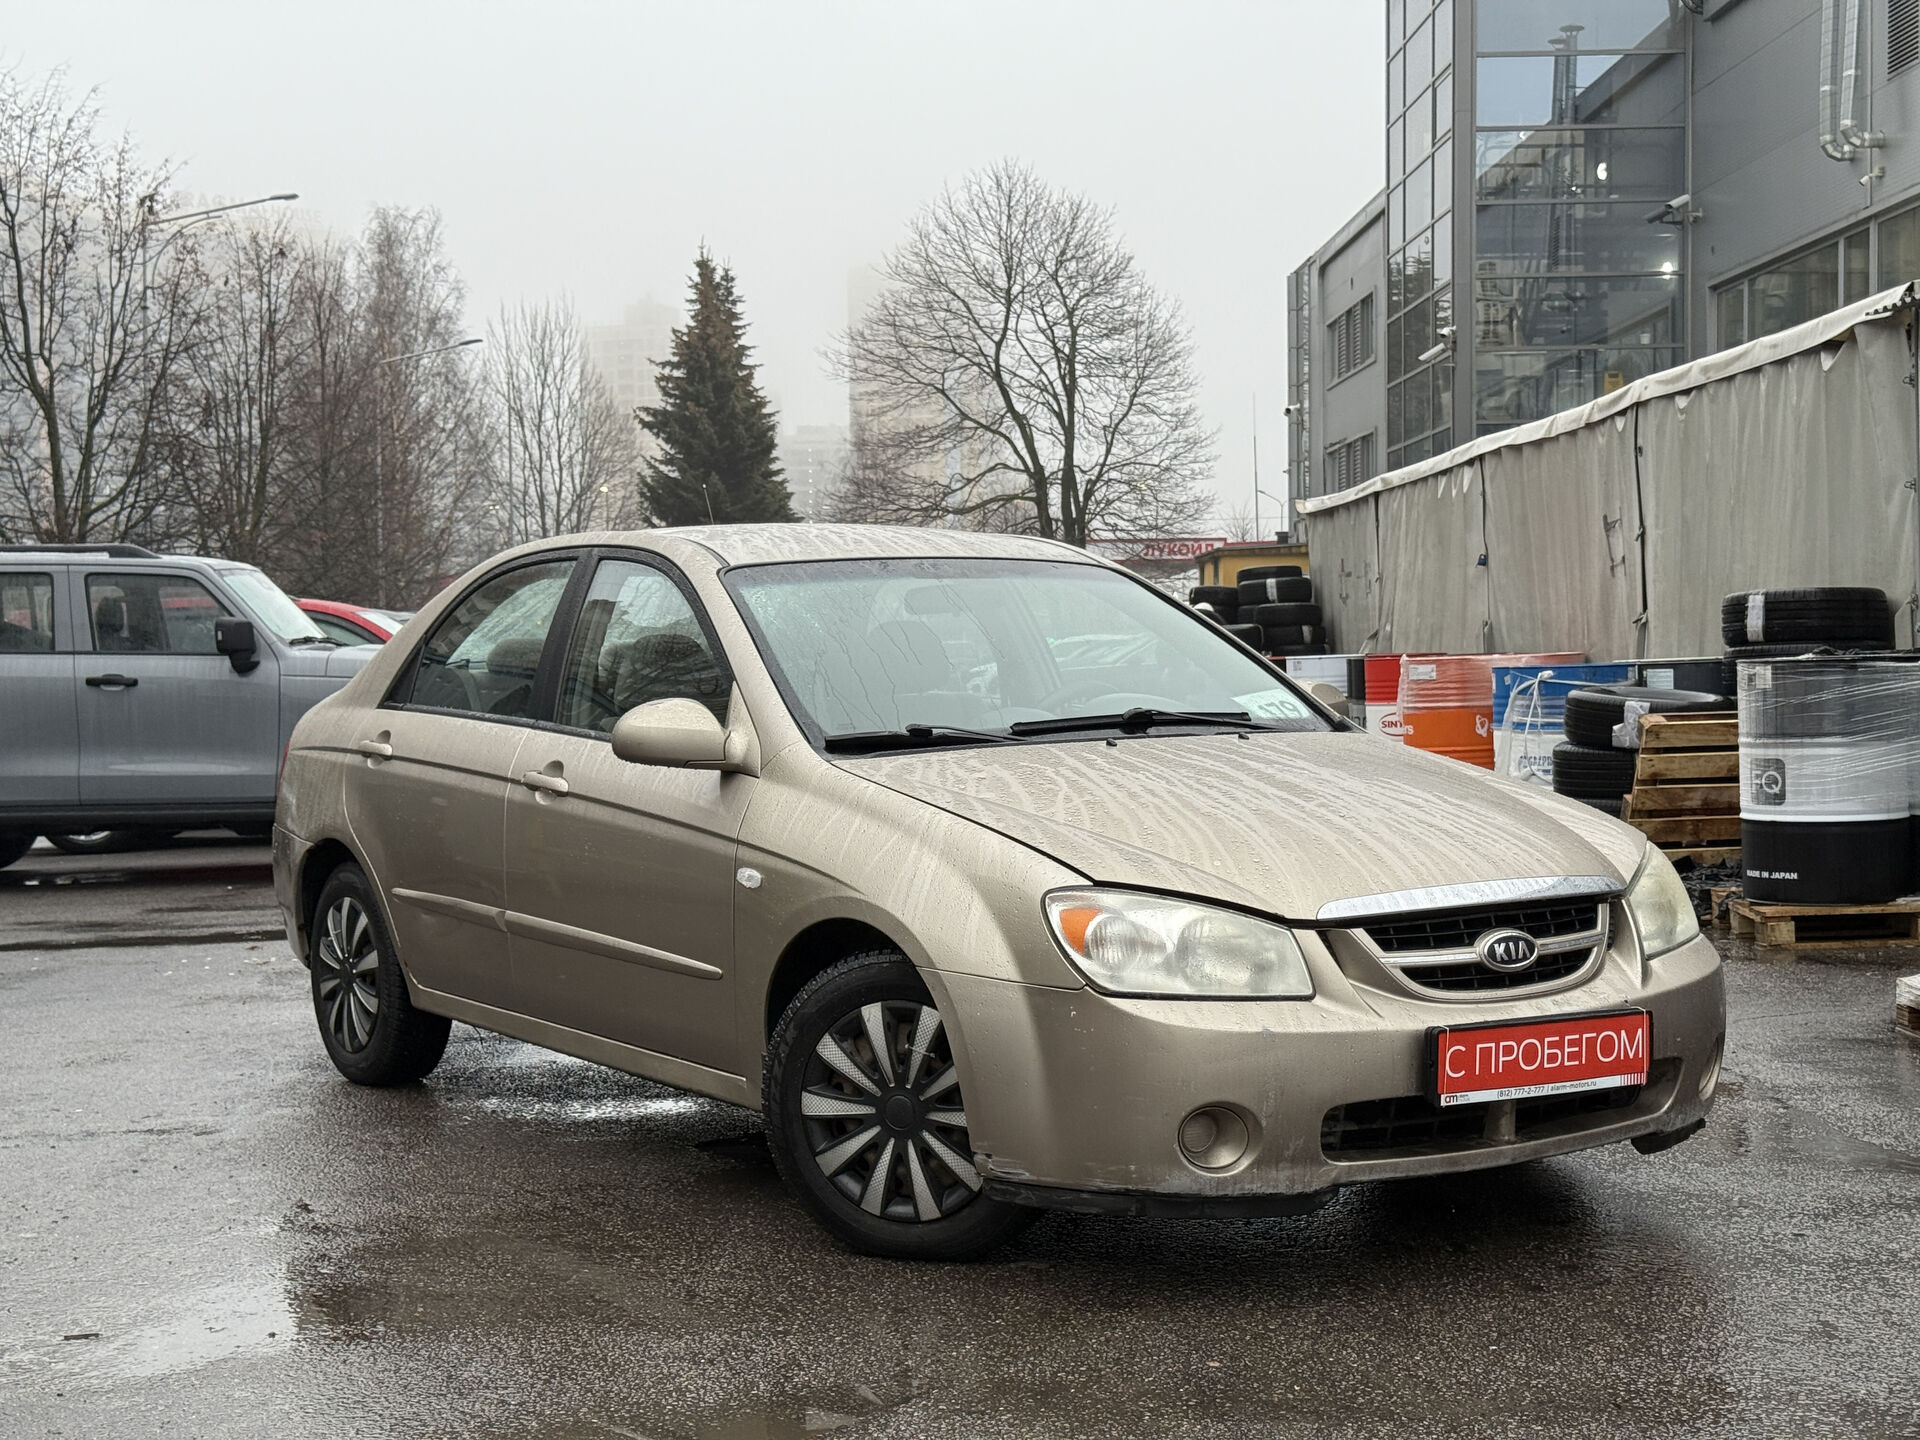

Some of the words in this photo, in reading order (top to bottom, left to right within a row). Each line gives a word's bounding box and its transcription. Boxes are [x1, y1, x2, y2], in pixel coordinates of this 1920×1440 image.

[1746, 869, 1760, 878] MADE
[1770, 872, 1798, 880] JAPAN
[1493, 940, 1530, 961] KIA
[1446, 1045, 1466, 1078] С
[1475, 1027, 1643, 1076] ПРОБЕГОМ
[1497, 1088, 1513, 1099] (812)
[1513, 1086, 1545, 1096] 777-2-777
[1550, 1080, 1597, 1092] alarm-motors.ru
